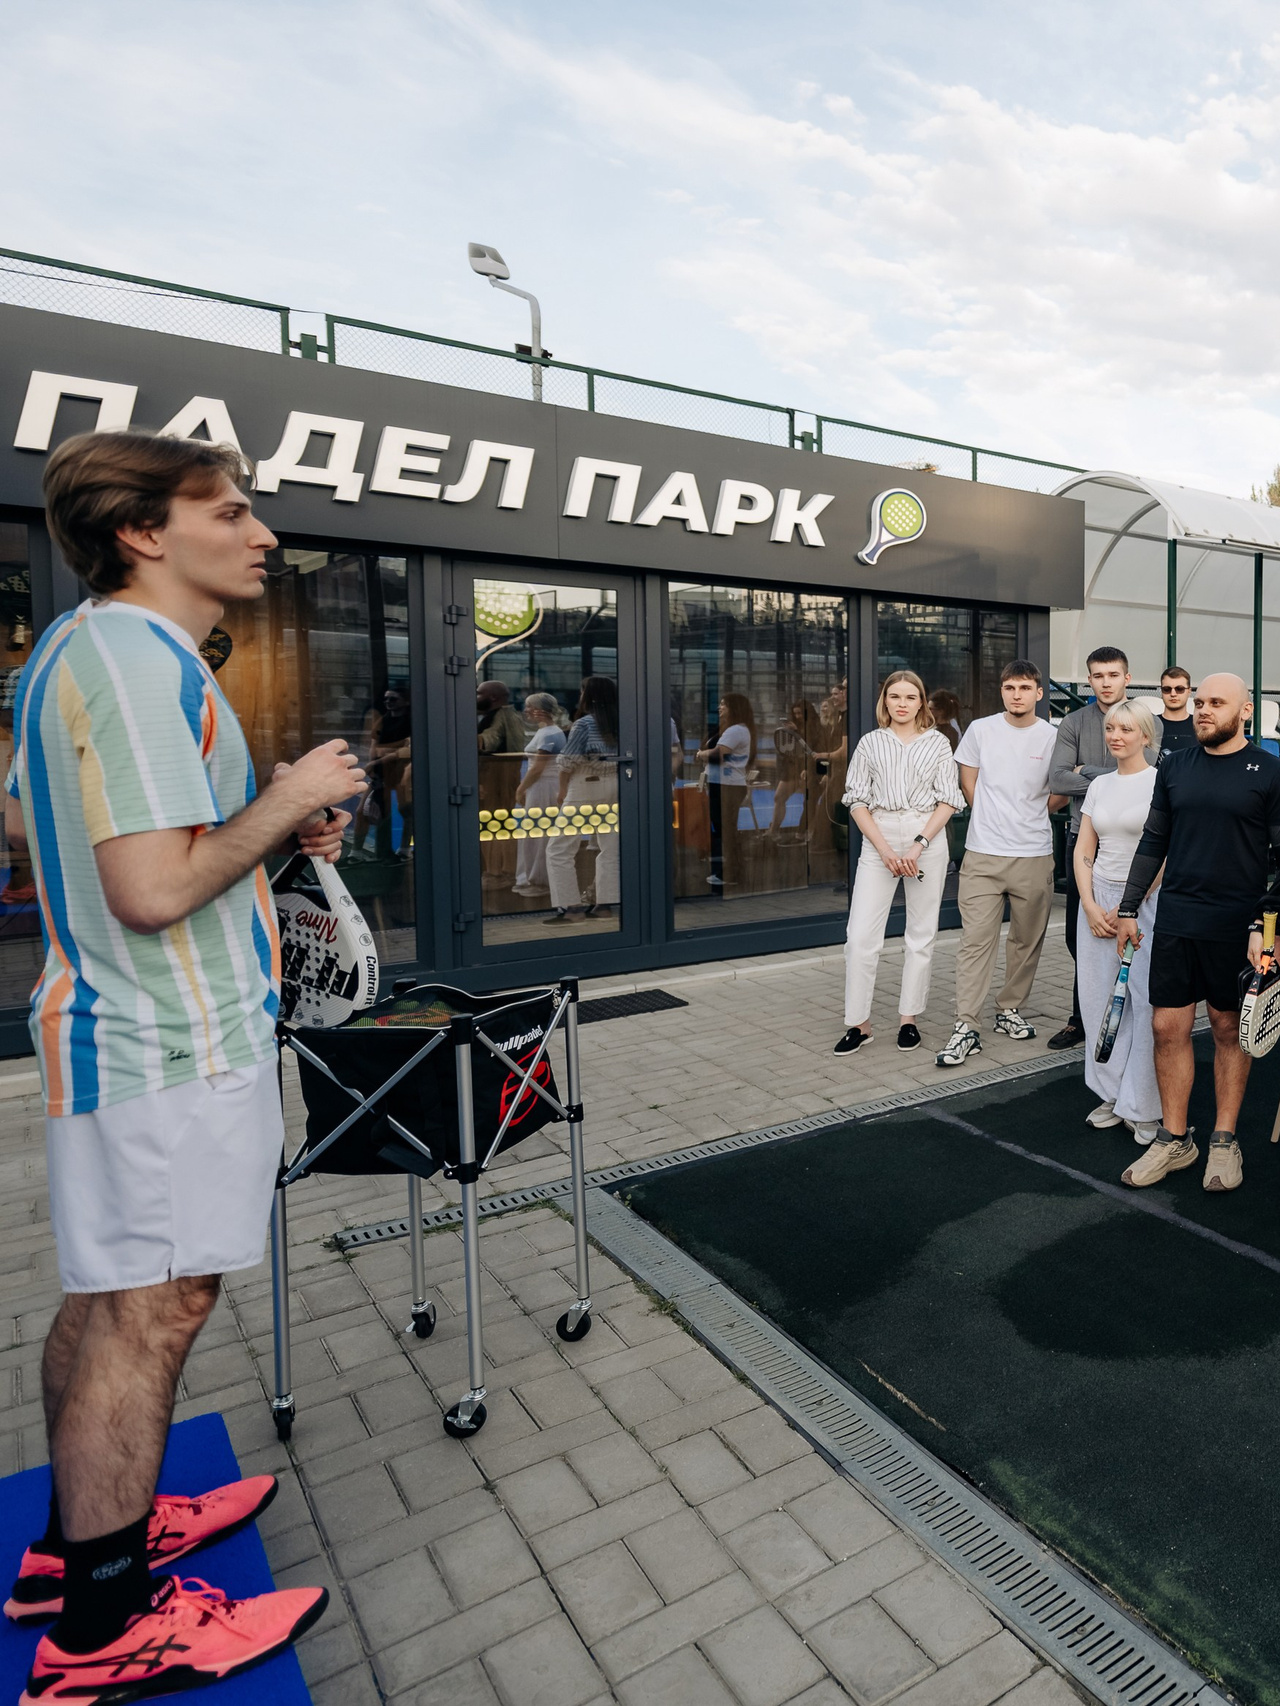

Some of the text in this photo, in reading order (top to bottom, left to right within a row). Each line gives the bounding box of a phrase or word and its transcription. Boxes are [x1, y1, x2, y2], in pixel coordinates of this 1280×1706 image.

[13, 370, 836, 548] ПАДЕЛ ПАРК
[295, 909, 339, 944] Nine
[365, 955, 377, 996] Control
[1240, 1004, 1253, 1055] INDIGA
